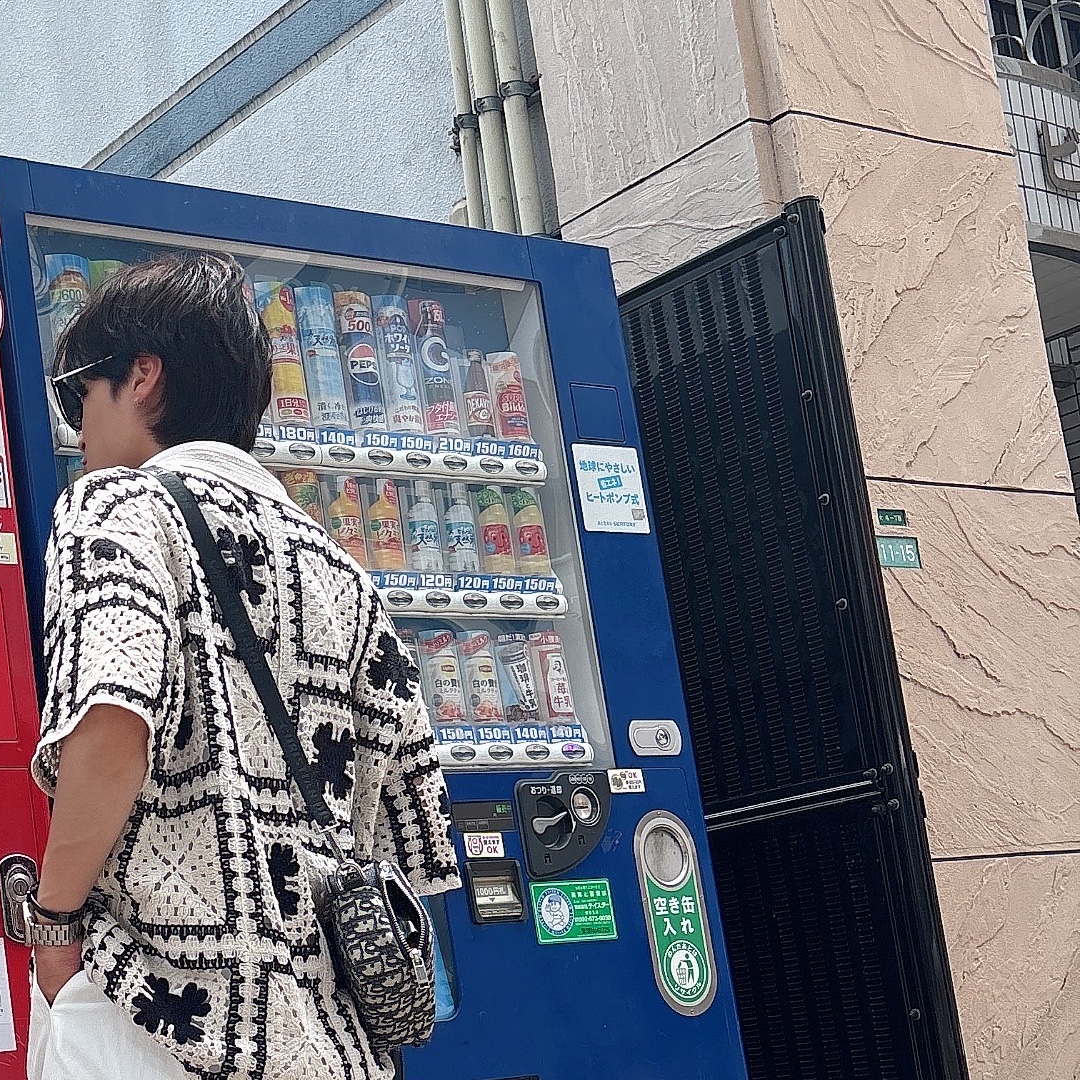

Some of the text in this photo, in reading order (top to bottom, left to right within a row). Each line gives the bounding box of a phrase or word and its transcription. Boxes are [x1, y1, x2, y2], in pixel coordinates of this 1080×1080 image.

[280, 427, 315, 441] 180円
[321, 431, 355, 445] 140円
[366, 434, 397, 447] 150円
[400, 436, 432, 450] 150円
[440, 438, 471, 451] 210円
[476, 441, 506, 455] 150円
[508, 444, 538, 458] 160円
[579, 459, 635, 474] 地球にやさしい
[586, 492, 639, 505] ヒートポンプ式
[881, 544, 915, 561] 11-15
[384, 574, 416, 587] 150円
[420, 575, 453, 588] 120円
[459, 576, 489, 590] 120円
[492, 578, 522, 590] 150円
[524, 578, 555, 592] 150円
[479, 728, 510, 740] 150円
[515, 727, 546, 739] 140円
[487, 846, 499, 854] OK
[654, 896, 695, 915] 空き缶
[664, 917, 694, 936] 入れ
